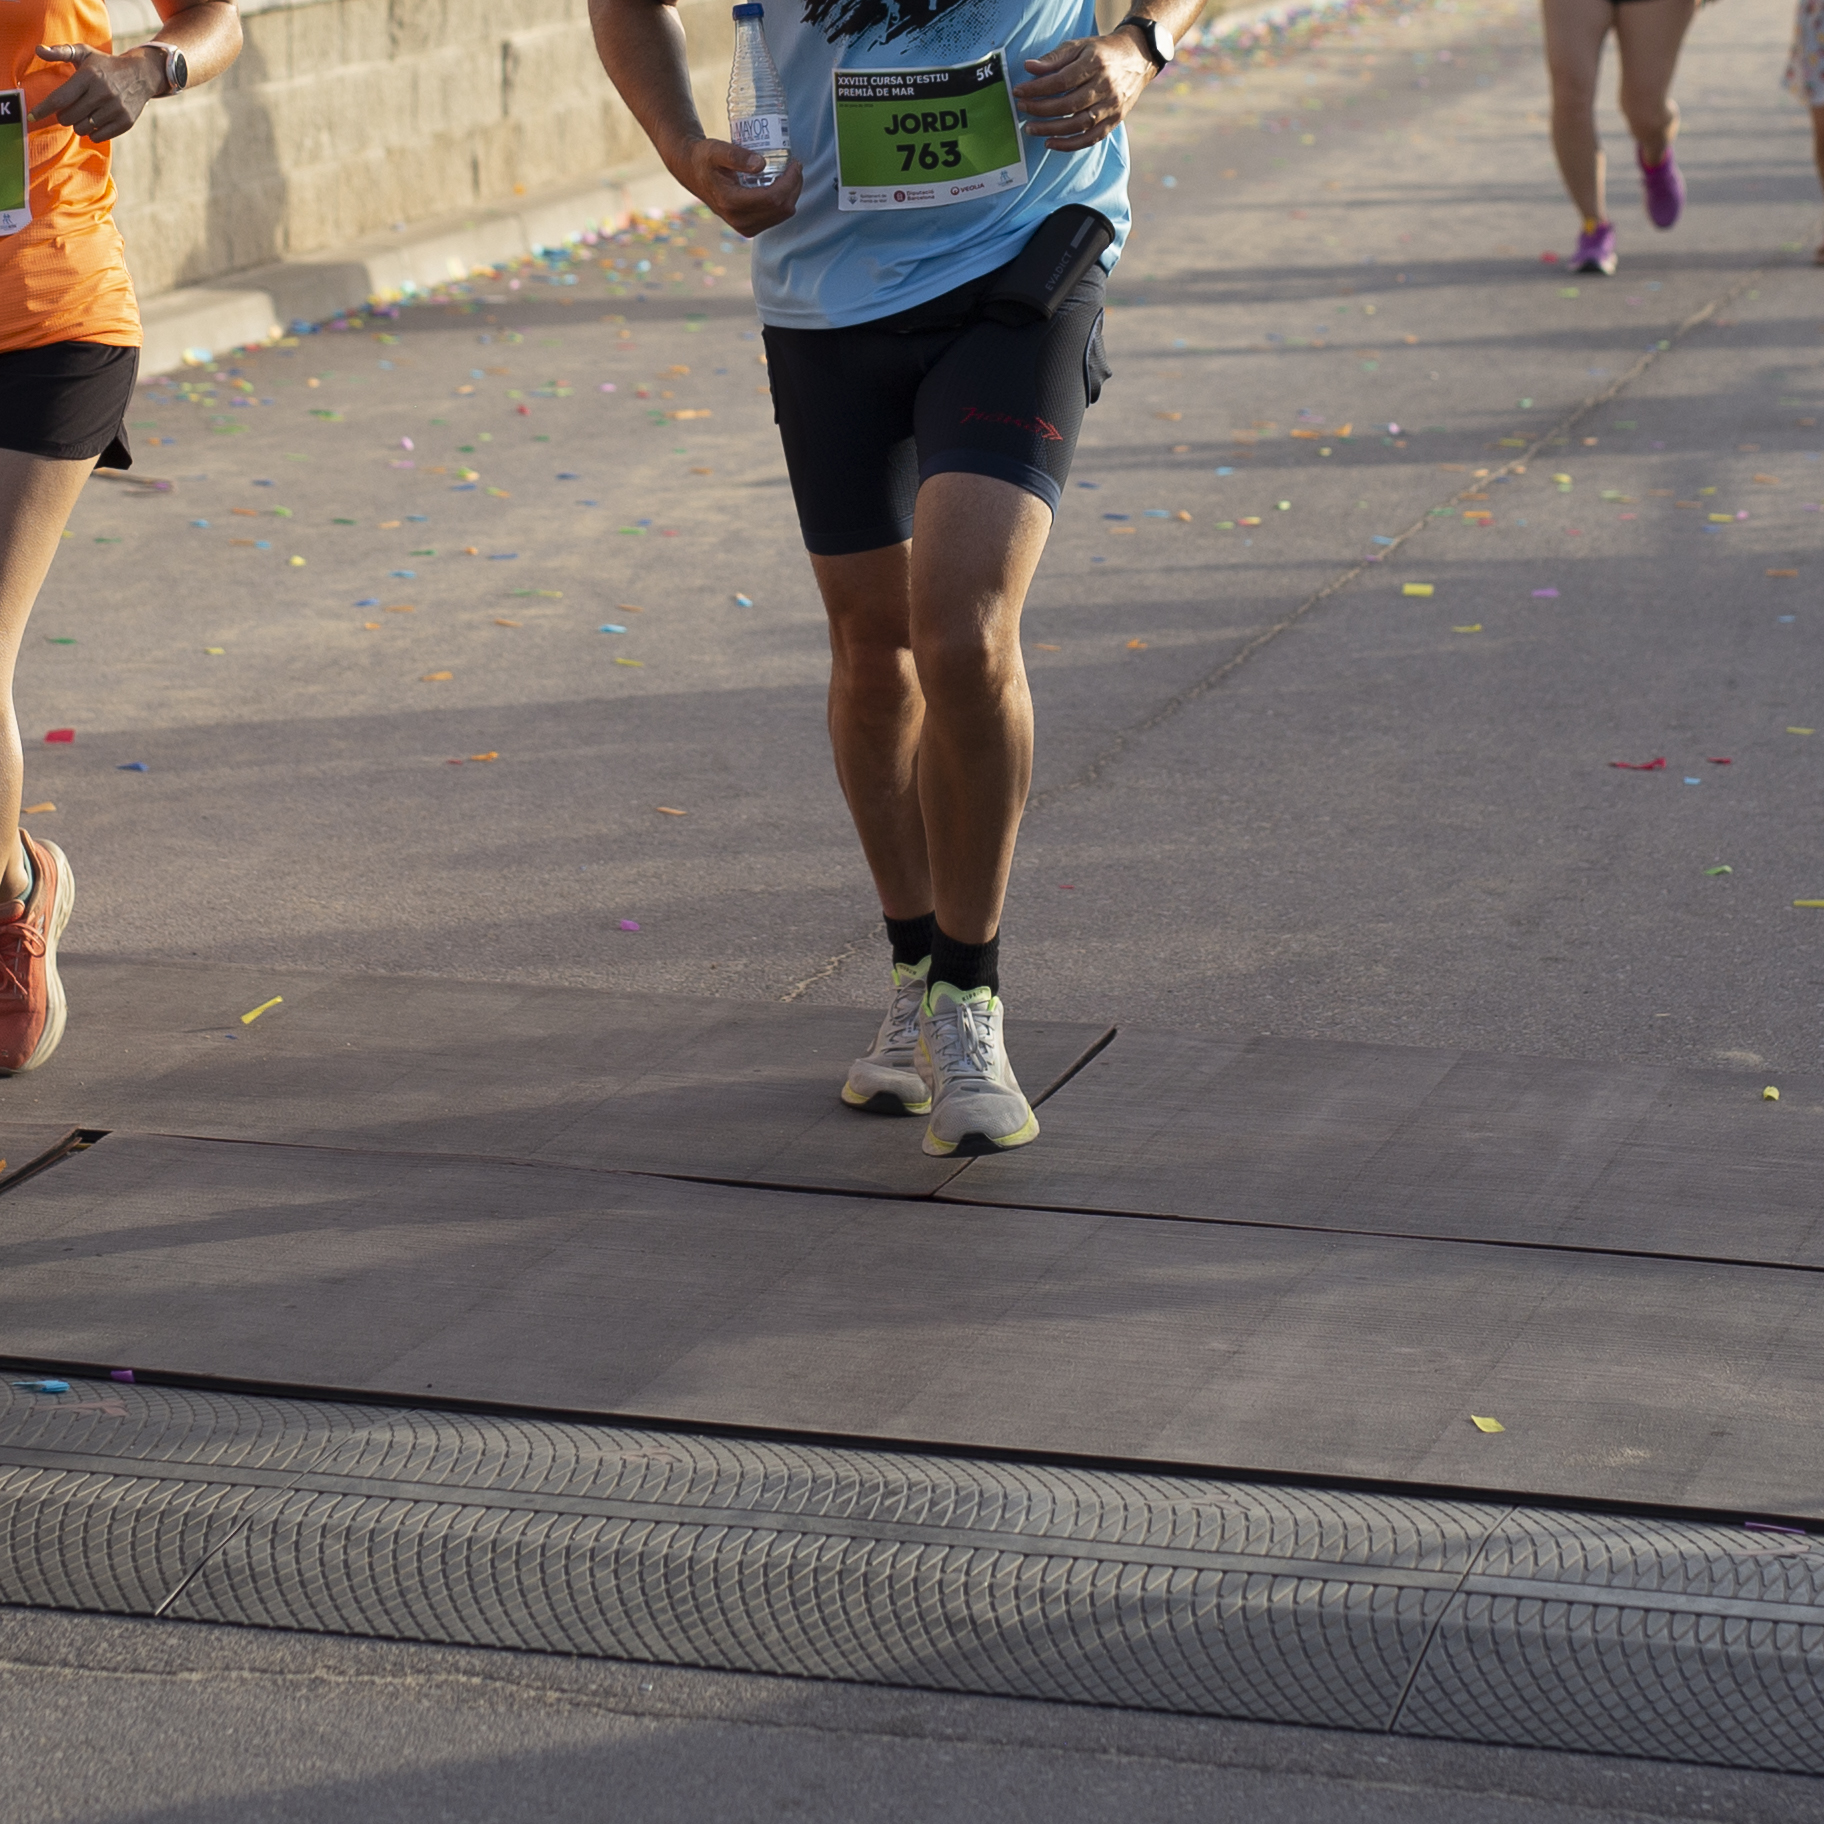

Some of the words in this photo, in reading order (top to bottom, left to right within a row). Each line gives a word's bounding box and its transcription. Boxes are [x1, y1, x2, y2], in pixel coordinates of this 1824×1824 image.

[837, 77, 868, 85] XXVIII
[870, 76, 903, 85] CURSA
[906, 73, 949, 84] D'ESTIU
[976, 63, 994, 81] 5K
[838, 85, 874, 96] PREMIÀ
[876, 87, 889, 96] DE
[892, 87, 915, 96] MAR
[884, 108, 968, 135] JORDI
[896, 139, 962, 172] 763
[1044, 250, 1073, 292] EVADICT
